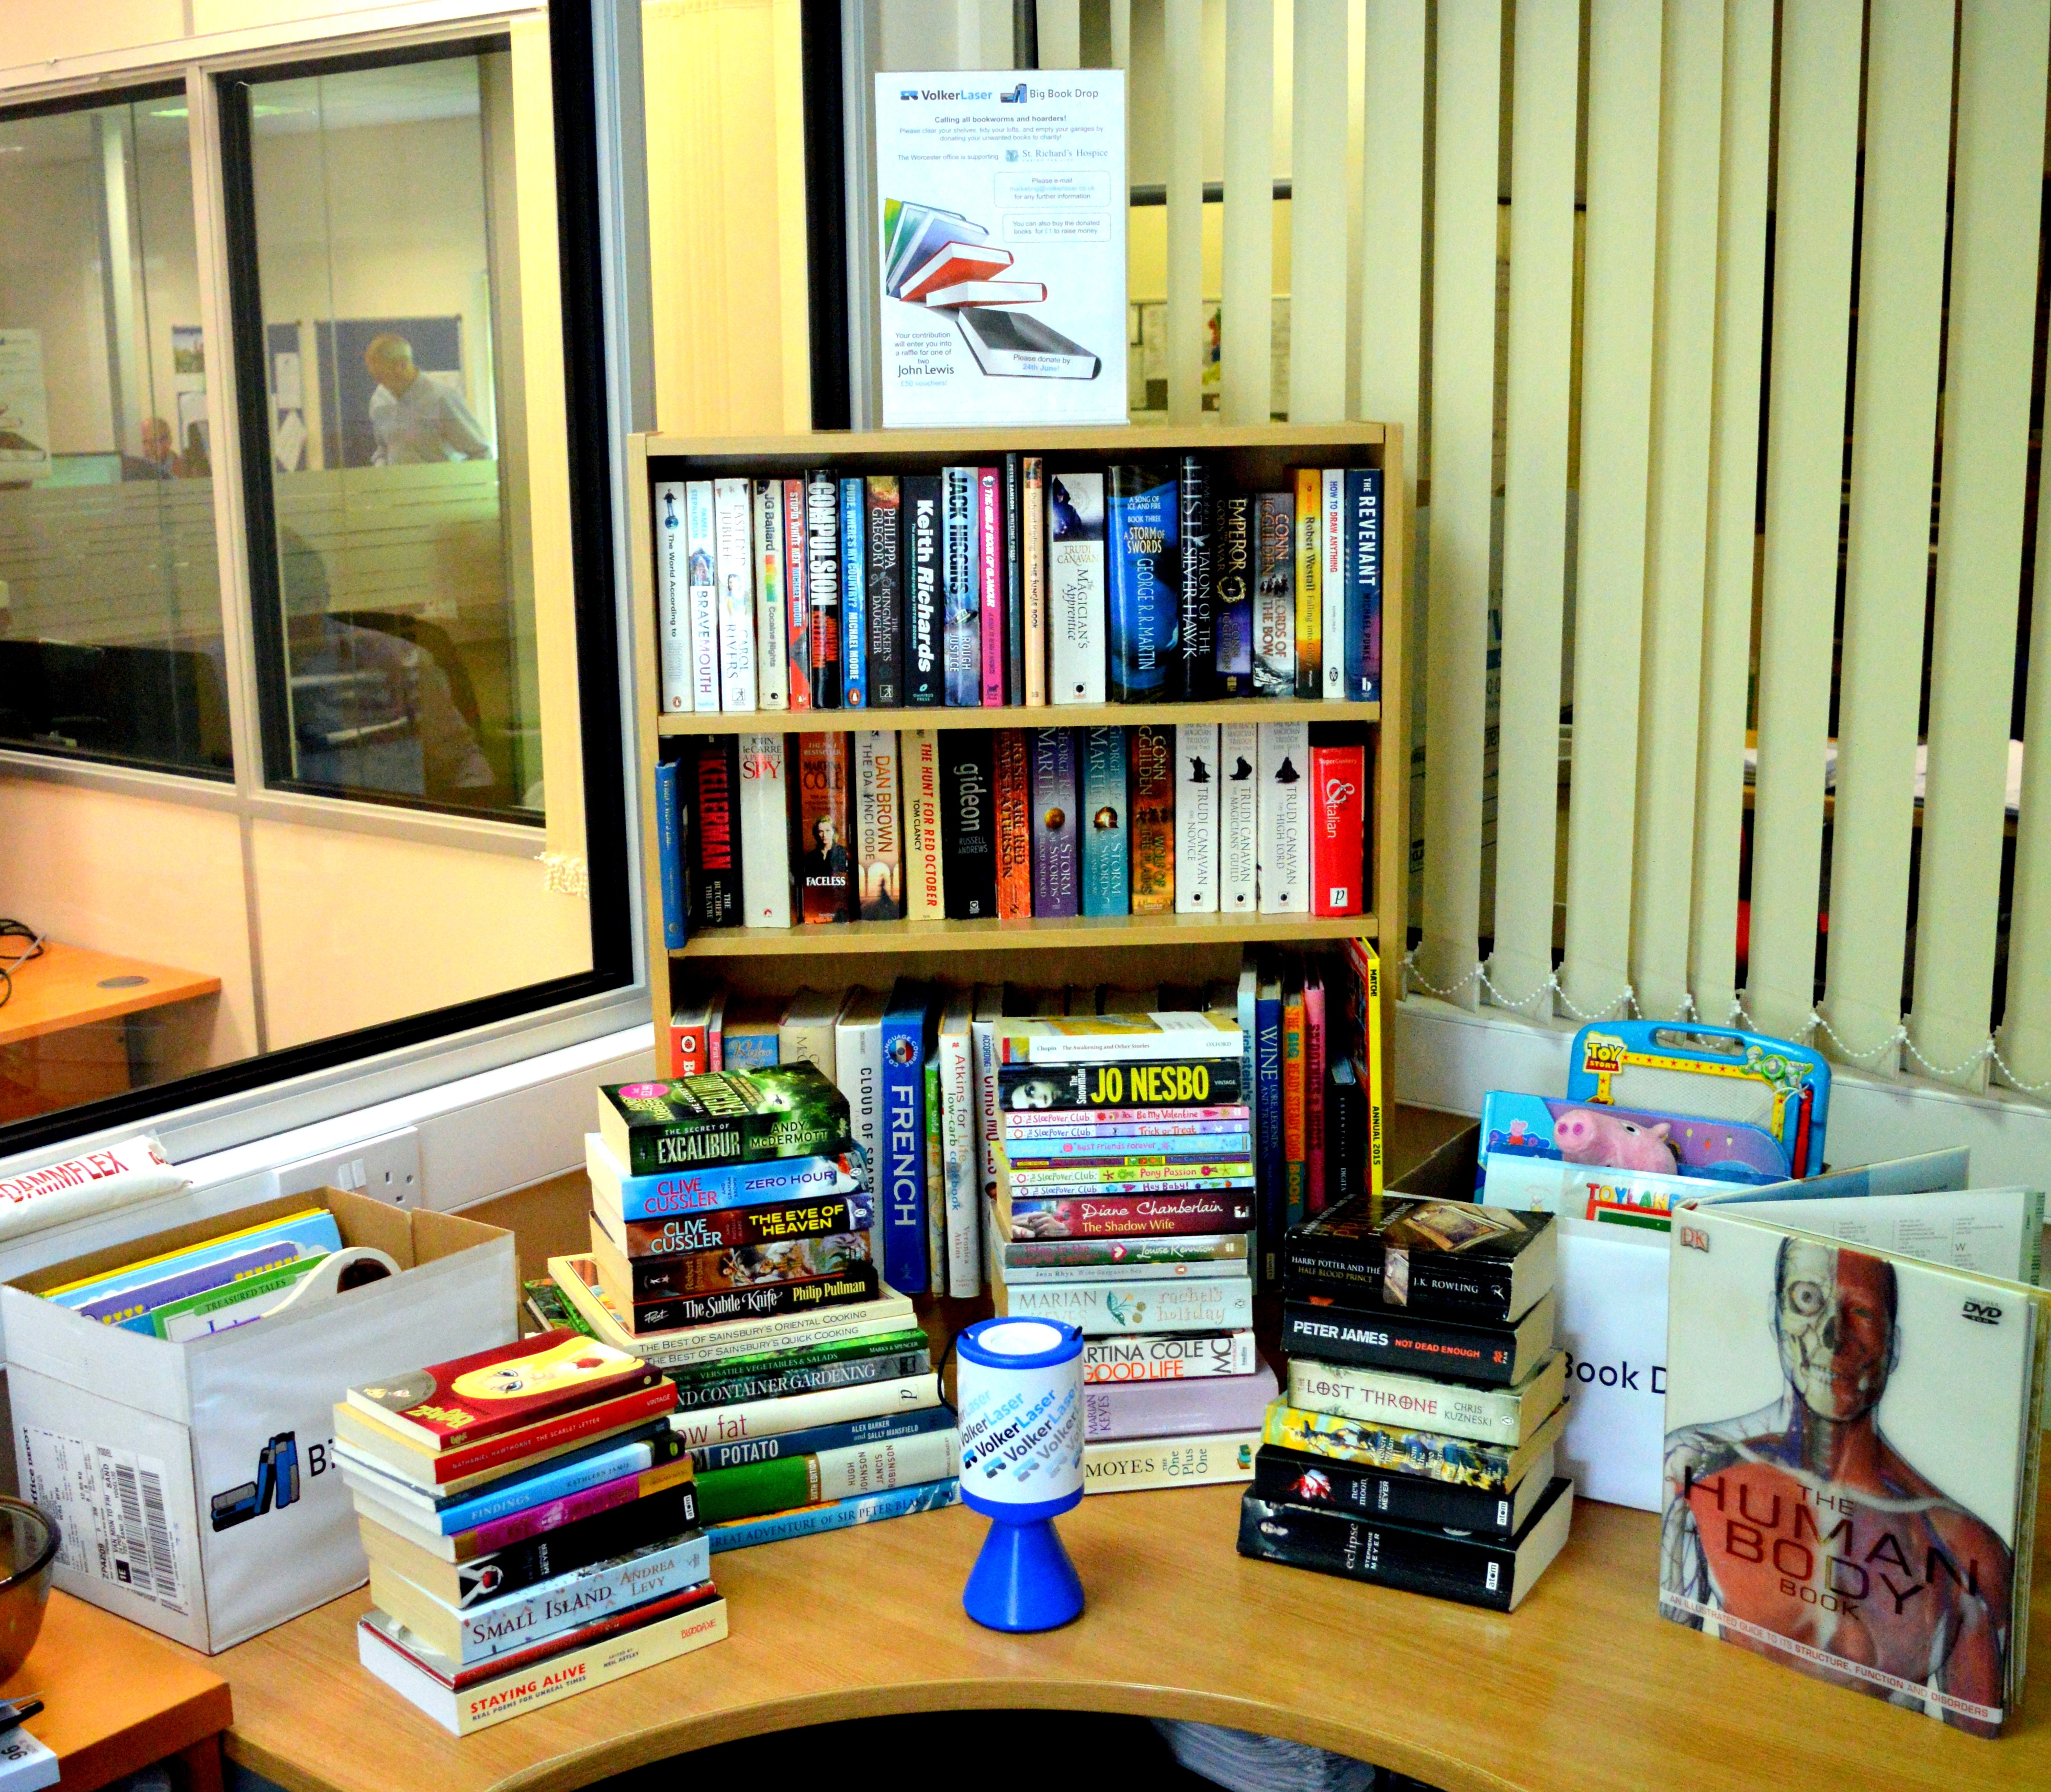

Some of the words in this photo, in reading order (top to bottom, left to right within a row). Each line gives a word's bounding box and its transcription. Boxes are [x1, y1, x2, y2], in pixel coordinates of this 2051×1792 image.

[921, 90, 993, 101] VolkerLaser
[1030, 89, 1045, 99] Big
[1048, 89, 1072, 98] Book
[1075, 89, 1099, 99] Drop
[1077, 149, 1108, 157] Hospice
[898, 365, 922, 378] John
[925, 365, 954, 375] Lewis
[948, 471, 968, 520] JACK
[1362, 478, 1371, 492] THE
[1330, 501, 1338, 510] TO
[808, 482, 837, 605] COMPULSION
[872, 508, 884, 568] GREGORY
[883, 508, 896, 569] PHILIPPA
[917, 500, 933, 562] Keith
[1130, 527, 1157, 540] STORM
[1157, 530, 1165, 538] OF
[1359, 496, 1376, 587] REVENANT
[950, 525, 968, 595] HIGGINS
[1128, 540, 1162, 554] SWORDS
[671, 628, 677, 637] to
[916, 567, 934, 672] Richards
[696, 590, 712, 693] BRAVEMOUTH
[950, 634, 959, 672] JUSTICE
[961, 636, 971, 670] ROUGH
[921, 743, 931, 762] THE
[743, 761, 780, 779] SPY
[875, 756, 890, 788] DAN
[921, 767, 933, 798] HUNT
[953, 763, 987, 831] gideon
[1198, 787, 1208, 824] TRUDI
[876, 795, 893, 853] BROWN
[923, 802, 934, 824] FOR
[924, 829, 936, 851] RED
[1197, 828, 1208, 885] CANAVAN
[806, 876, 846, 886] FACELESS
[925, 854, 937, 906] OCTOBER
[1260, 1024, 1278, 1081] WINE
[1588, 1043, 1624, 1061] TOY
[1077, 1069, 1087, 1104] Snowman
[1090, 1067, 1122, 1103] JO
[1131, 1065, 1209, 1101] NESBO
[751, 1130, 828, 1148] McDERMOTT
[772, 1121, 806, 1133] ANDY
[657, 1131, 740, 1164] EXCALIBUR
[891, 1085, 916, 1226] FRENCH
[657, 1177, 702, 1196] CLIVE
[745, 1177, 786, 1190] ZERO
[791, 1171, 833, 1185] HOUR
[645, 1193, 718, 1214] CUSSLER
[749, 1214, 783, 1226] THE
[785, 1210, 819, 1222] EYE
[822, 1205, 844, 1216] OF
[1082, 1203, 1129, 1219] Diane
[1137, 1199, 1223, 1215] Chamberlain
[663, 1219, 707, 1238] CLIVE
[763, 1219, 832, 1236] HEAVEN
[1083, 1222, 1102, 1232] The
[1105, 1221, 1147, 1232] Shadow
[1150, 1220, 1175, 1230] Wife
[1682, 1229, 1707, 1248] DK
[651, 1232, 723, 1255] CUSSLER
[205, 1288, 258, 1312] TREASURED
[258, 1279, 286, 1293] TALES
[683, 1301, 705, 1318] The
[705, 1295, 740, 1317] Subtle
[741, 1288, 783, 1310] Knife
[1963, 1302, 2002, 1318] DVD
[1293, 1320, 1338, 1338] PETER
[1340, 1325, 1388, 1346] JAMES
[1151, 1341, 1203, 1358] COLE
[1395, 1339, 1412, 1348] NOT
[1414, 1341, 1439, 1353] DEAD
[1441, 1343, 1480, 1358] ENOUGH
[1150, 1360, 1184, 1378] LIFE
[701, 1377, 788, 1403] CONTAINER
[790, 1363, 875, 1390] GARDENING
[646, 1393, 671, 1406] VINTAGE
[975, 1389, 1057, 1458] VolkerLaser
[720, 1440, 778, 1466] POTATO
[1168, 1450, 1180, 1476] One
[1182, 1449, 1194, 1475] Plus
[1196, 1449, 1208, 1473] One
[104, 1464, 112, 1489] SAND
[1086, 1458, 1154, 1477] MOYES
[1797, 1484, 1855, 1517] THE
[1684, 1466, 1978, 1596] HUMAN
[1726, 1518, 1924, 1615] BODY
[1780, 1578, 1860, 1621] BOOK
[473, 1611, 537, 1646] SMALL
[545, 1586, 612, 1621] ISLAND
[1670, 1595, 1681, 1605] AN
[1684, 1598, 1737, 1628] ILLUSTRATED
[1739, 1622, 1765, 1639] GUIDE
[1767, 1630, 1777, 1643] TO
[1779, 1638, 1793, 1650] ITS
[1795, 1645, 1852, 1672] STRUCTURE,
[1855, 1666, 1904, 1689] FUNCTION
[1907, 1684, 1928, 1696] AND
[1931, 1691, 1989, 1718] DISORDERS
[470, 1683, 538, 1715] STAYING
[542, 1663, 586, 1689] ALIVE
